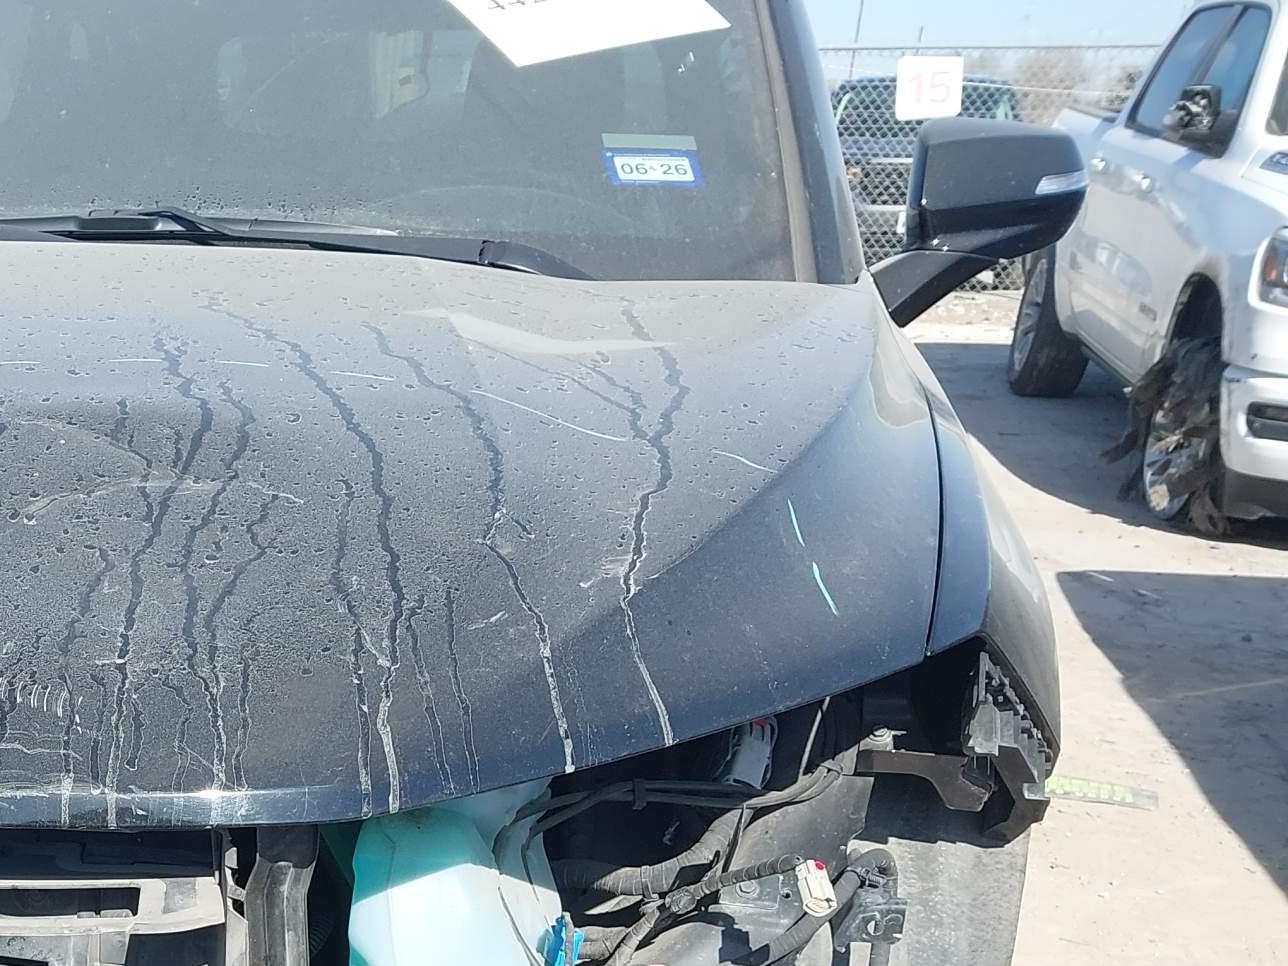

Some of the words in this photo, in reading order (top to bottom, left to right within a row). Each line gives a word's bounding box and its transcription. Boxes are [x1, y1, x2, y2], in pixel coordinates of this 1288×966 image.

[909, 71, 952, 105] 15
[620, 162, 649, 176] 06
[659, 163, 689, 176] 26
